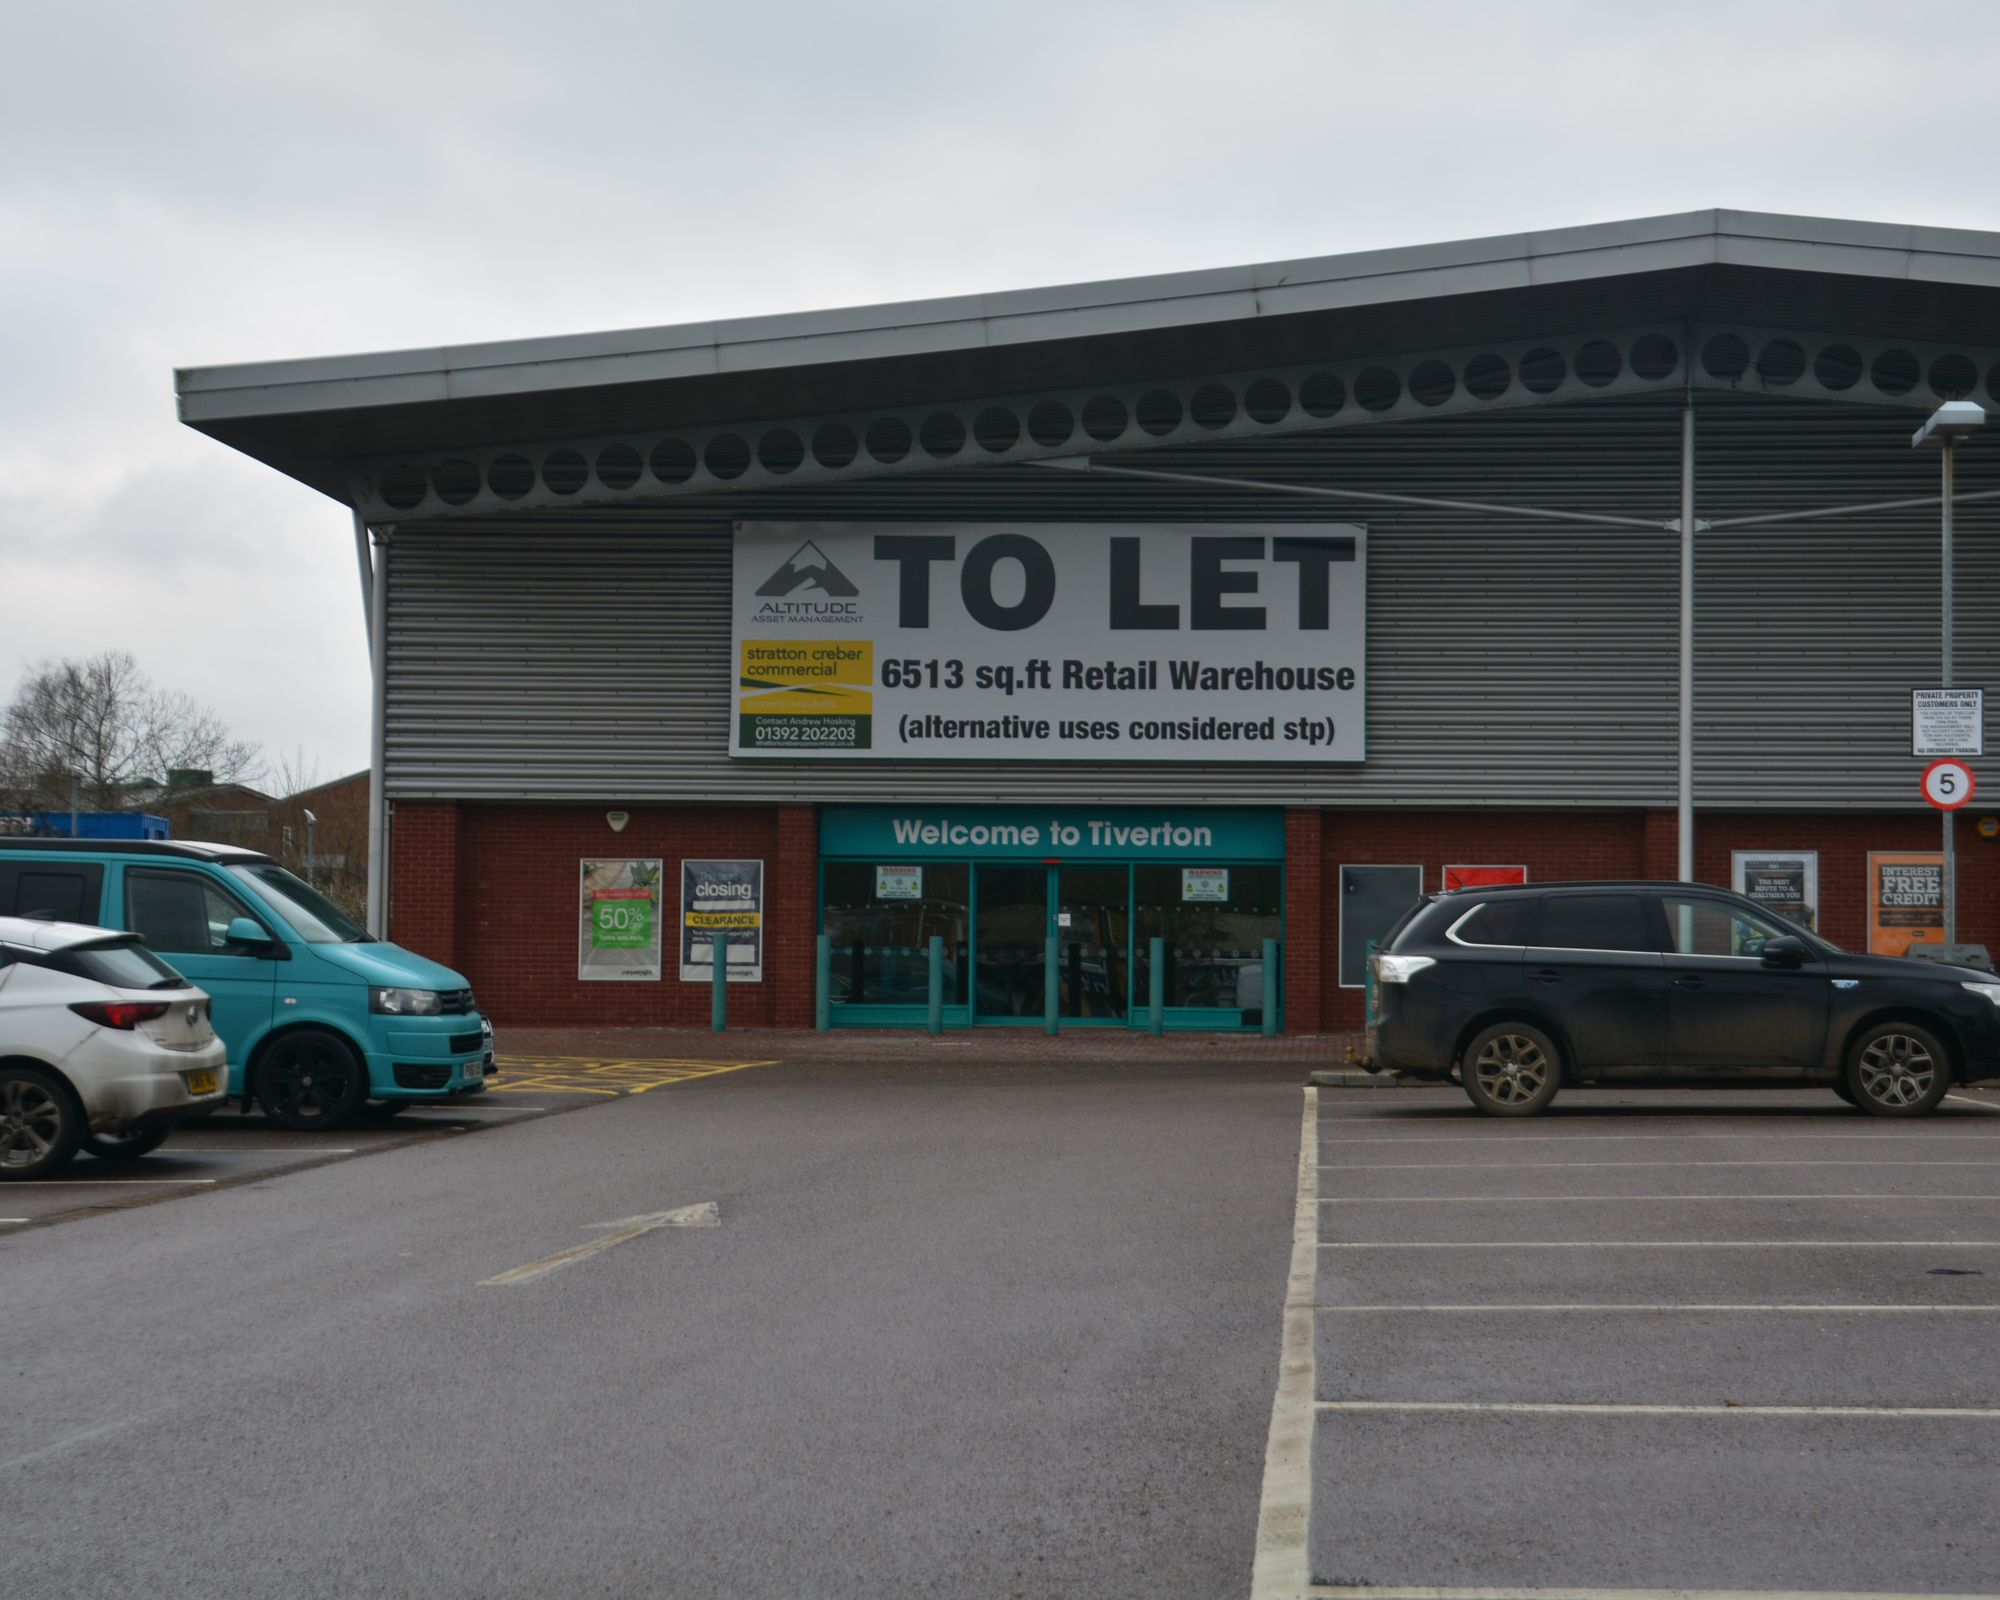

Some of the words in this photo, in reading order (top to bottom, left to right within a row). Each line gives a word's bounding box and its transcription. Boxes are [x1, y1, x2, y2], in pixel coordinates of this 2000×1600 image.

[874, 534, 1056, 631] TO
[1110, 537, 1355, 630] LET
[760, 603, 857, 614] ALTITUDE
[752, 615, 784, 623] ASSET
[787, 615, 864, 623] MANAGEMENT
[747, 647, 806, 660] stratton
[812, 646, 863, 660] creber
[747, 661, 837, 676] commercial
[881, 659, 964, 689] 6513
[976, 659, 1051, 695] sq.ft
[1063, 659, 1157, 690] Retail
[1168, 660, 1355, 690] Warehouse
[1917, 700, 1958, 708] CUSTOMERS
[1960, 700, 1977, 708] ONLY
[755, 717, 787, 725] Contact
[790, 717, 821, 725] Andrew
[823, 717, 856, 726] Hosking
[755, 727, 800, 740] 01392
[801, 727, 856, 741] 202203
[898, 713, 1049, 743] (alternative
[1058, 720, 1120, 740] uses
[1128, 716, 1274, 741] considered
[1283, 716, 1335, 746] stp)
[1940, 773, 1955, 795] 5
[893, 819, 1040, 846] Welcome
[1049, 820, 1082, 847] to
[1087, 820, 1213, 847] Tiverton
[1882, 866, 1940, 876] INTEREST
[695, 881, 752, 900] closing
[1882, 876, 1941, 894] FREE
[1882, 893, 1940, 905] CREDIT
[693, 914, 755, 926] CLEARANCE
